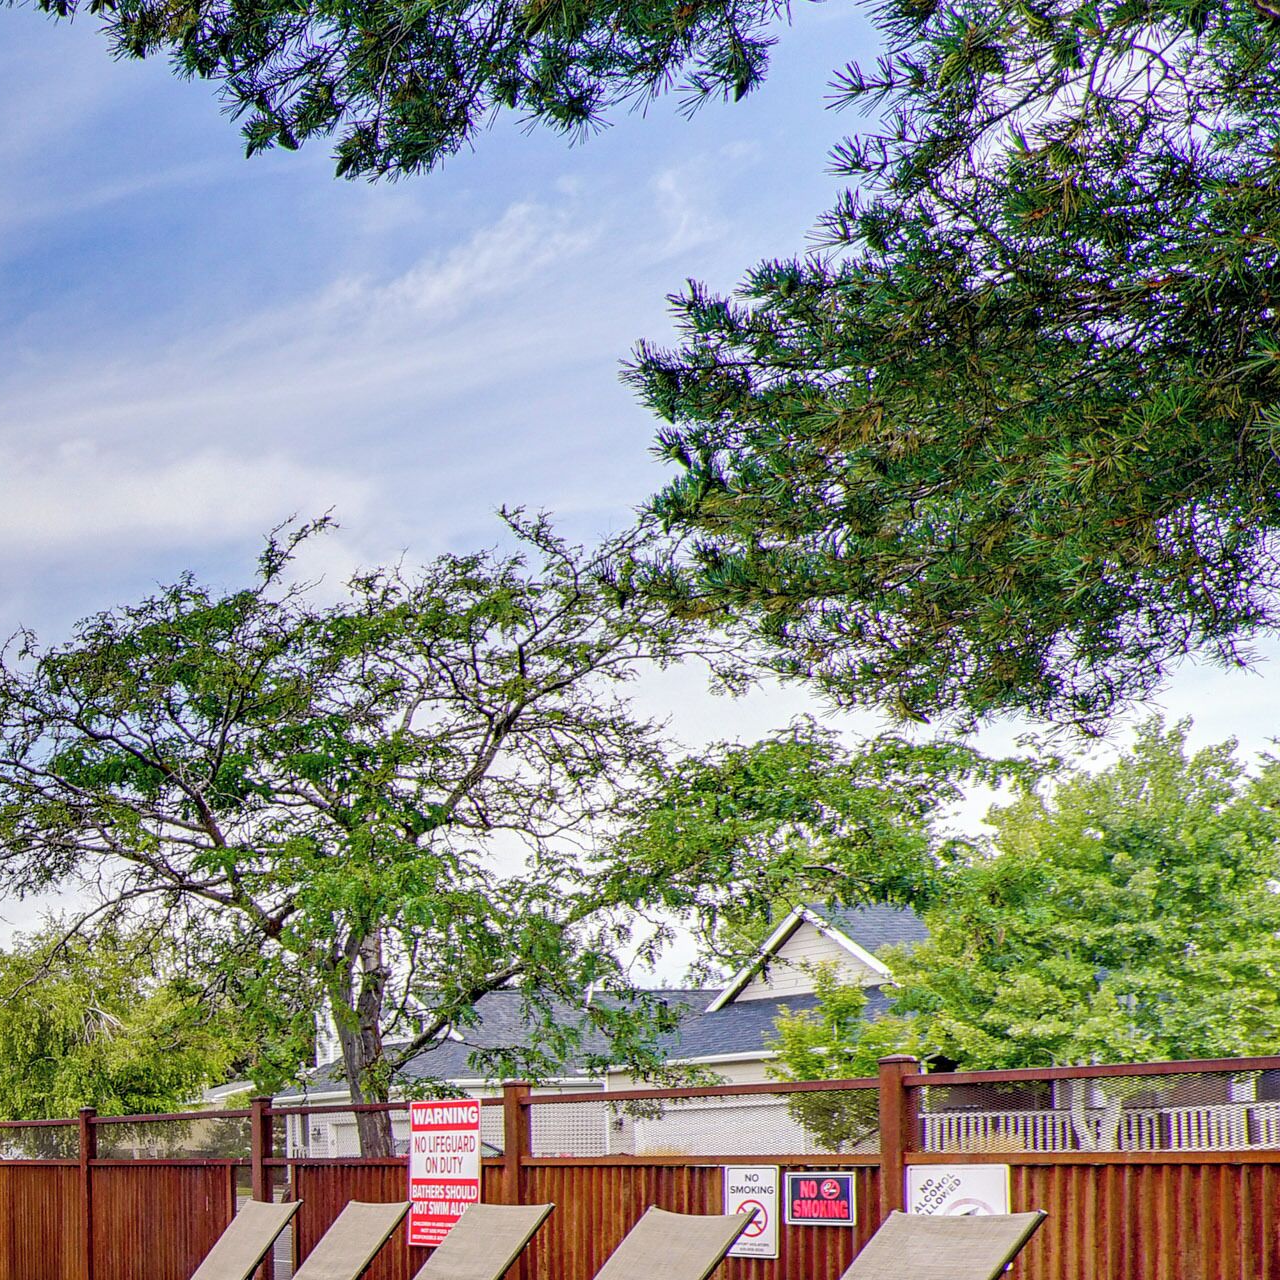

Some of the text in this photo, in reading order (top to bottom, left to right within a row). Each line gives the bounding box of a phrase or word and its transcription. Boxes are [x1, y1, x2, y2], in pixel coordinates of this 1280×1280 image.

[412, 1106, 479, 1125] WARNING
[414, 1135, 476, 1153] NO LIFEGUARD
[425, 1156, 463, 1174] ON DUTY
[744, 1173, 759, 1182] NO
[920, 1178, 934, 1194] NO
[412, 1184, 477, 1200] BATHERS SHOULD
[730, 1185, 774, 1195] SMOKING
[800, 1180, 818, 1198] NO
[914, 1173, 955, 1213] ALCOHOL
[921, 1178, 962, 1215] LLOWED
[413, 1201, 429, 1215] NOT
[429, 1201, 449, 1215] SWIM
[792, 1200, 849, 1219] SMOKING
